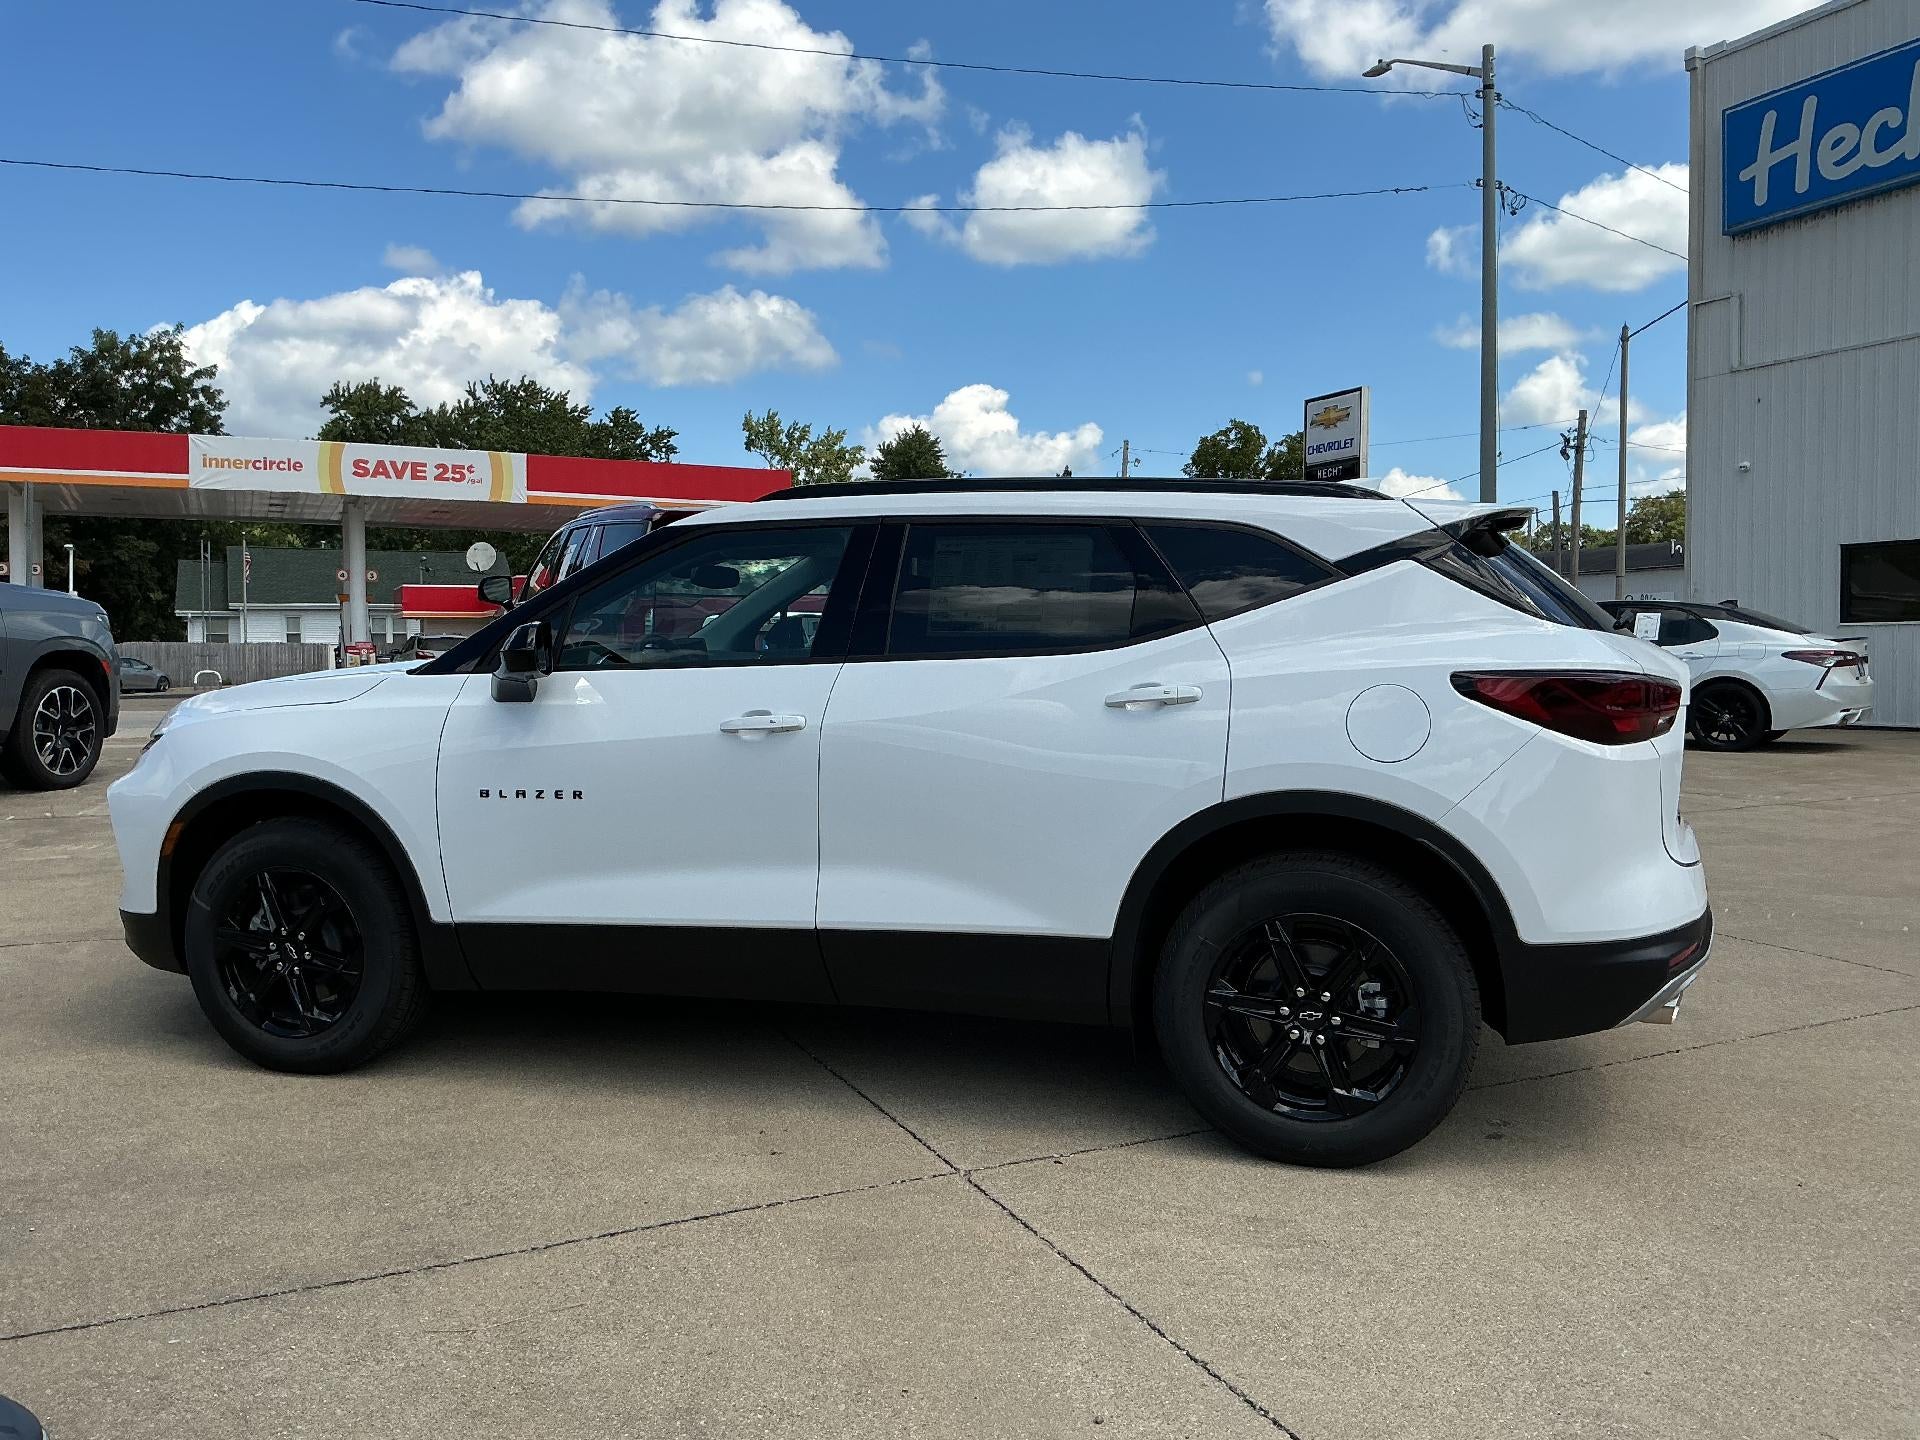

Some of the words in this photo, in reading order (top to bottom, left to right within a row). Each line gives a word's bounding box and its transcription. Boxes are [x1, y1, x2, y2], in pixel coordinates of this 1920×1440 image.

[1307, 438, 1355, 455] CHEVROLET
[202, 454, 304, 472] innercircle
[352, 459, 428, 481] SAVE
[1317, 466, 1343, 479] HECHT
[480, 789, 584, 800] BLAZER
